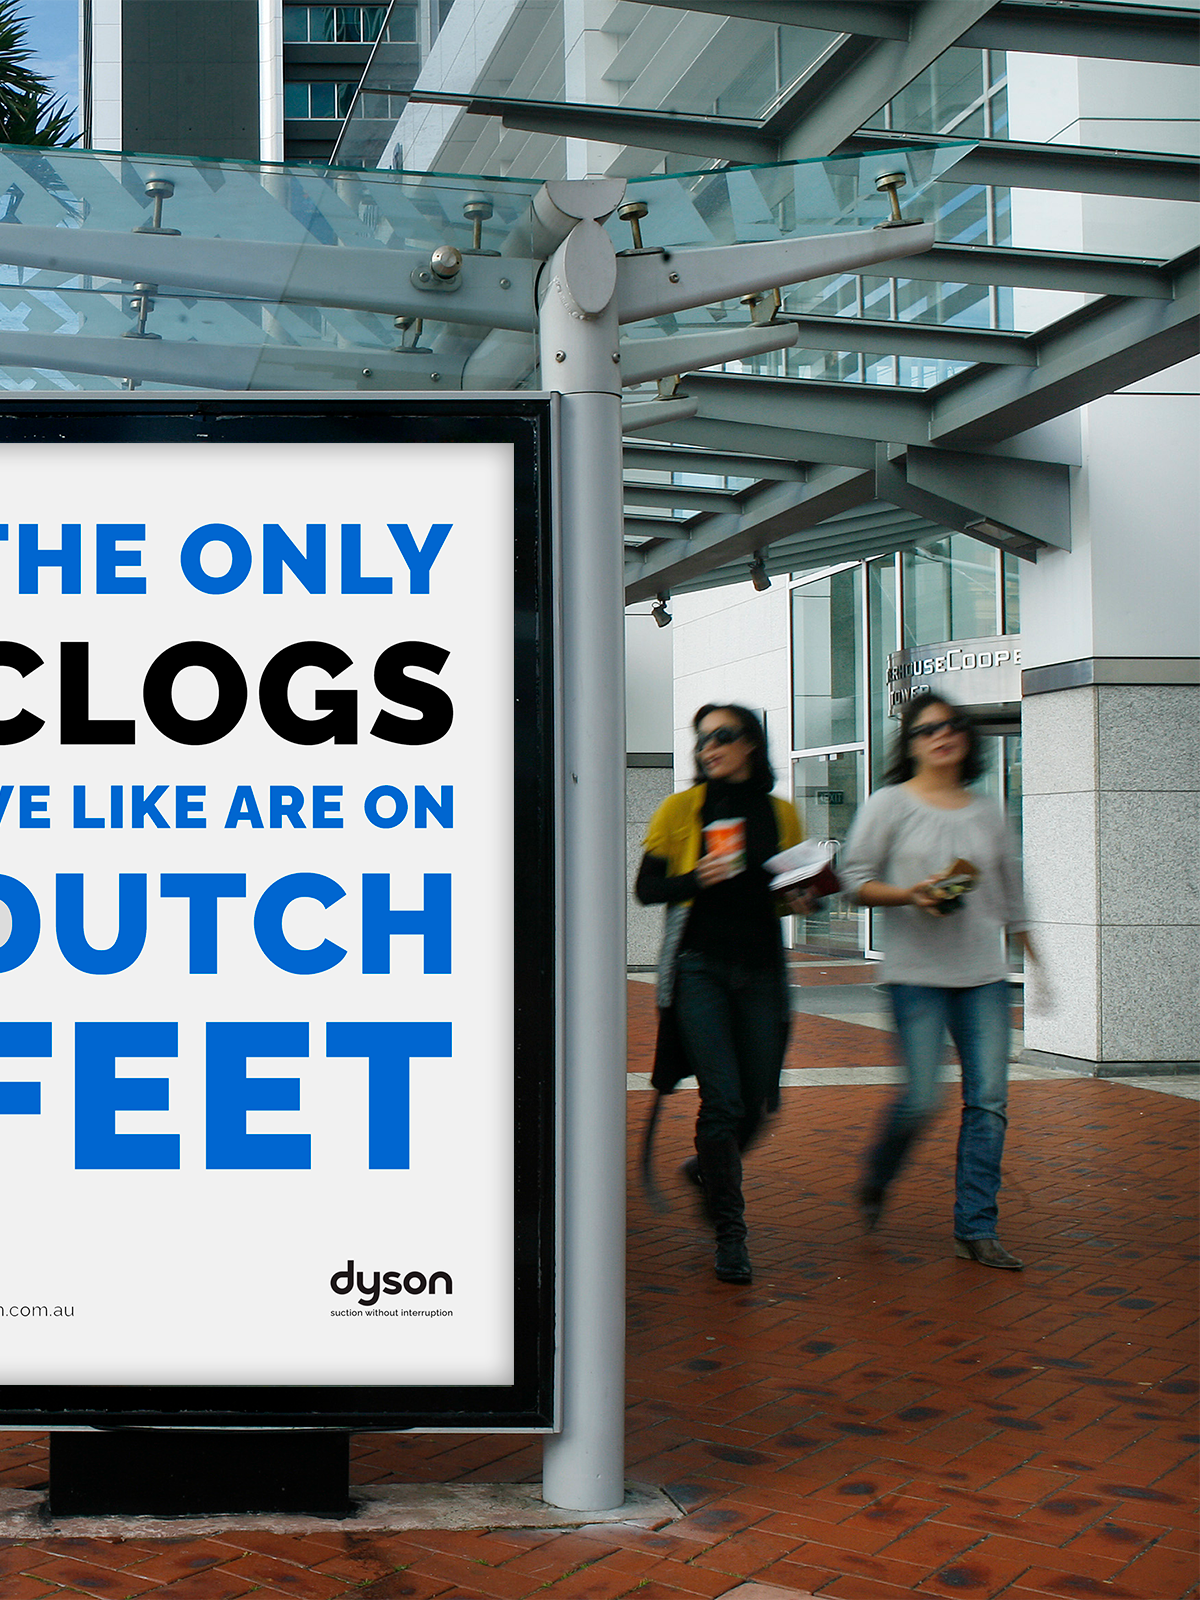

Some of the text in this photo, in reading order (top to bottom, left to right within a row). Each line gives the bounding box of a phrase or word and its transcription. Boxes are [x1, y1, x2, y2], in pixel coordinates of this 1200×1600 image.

[180, 523, 453, 595] ONLY
[73, 785, 206, 828] LIKE
[224, 785, 343, 828] ARE
[364, 785, 453, 829] ON
[330, 1260, 452, 1306] dyson
[330, 1309, 453, 1318] suction without interruption
